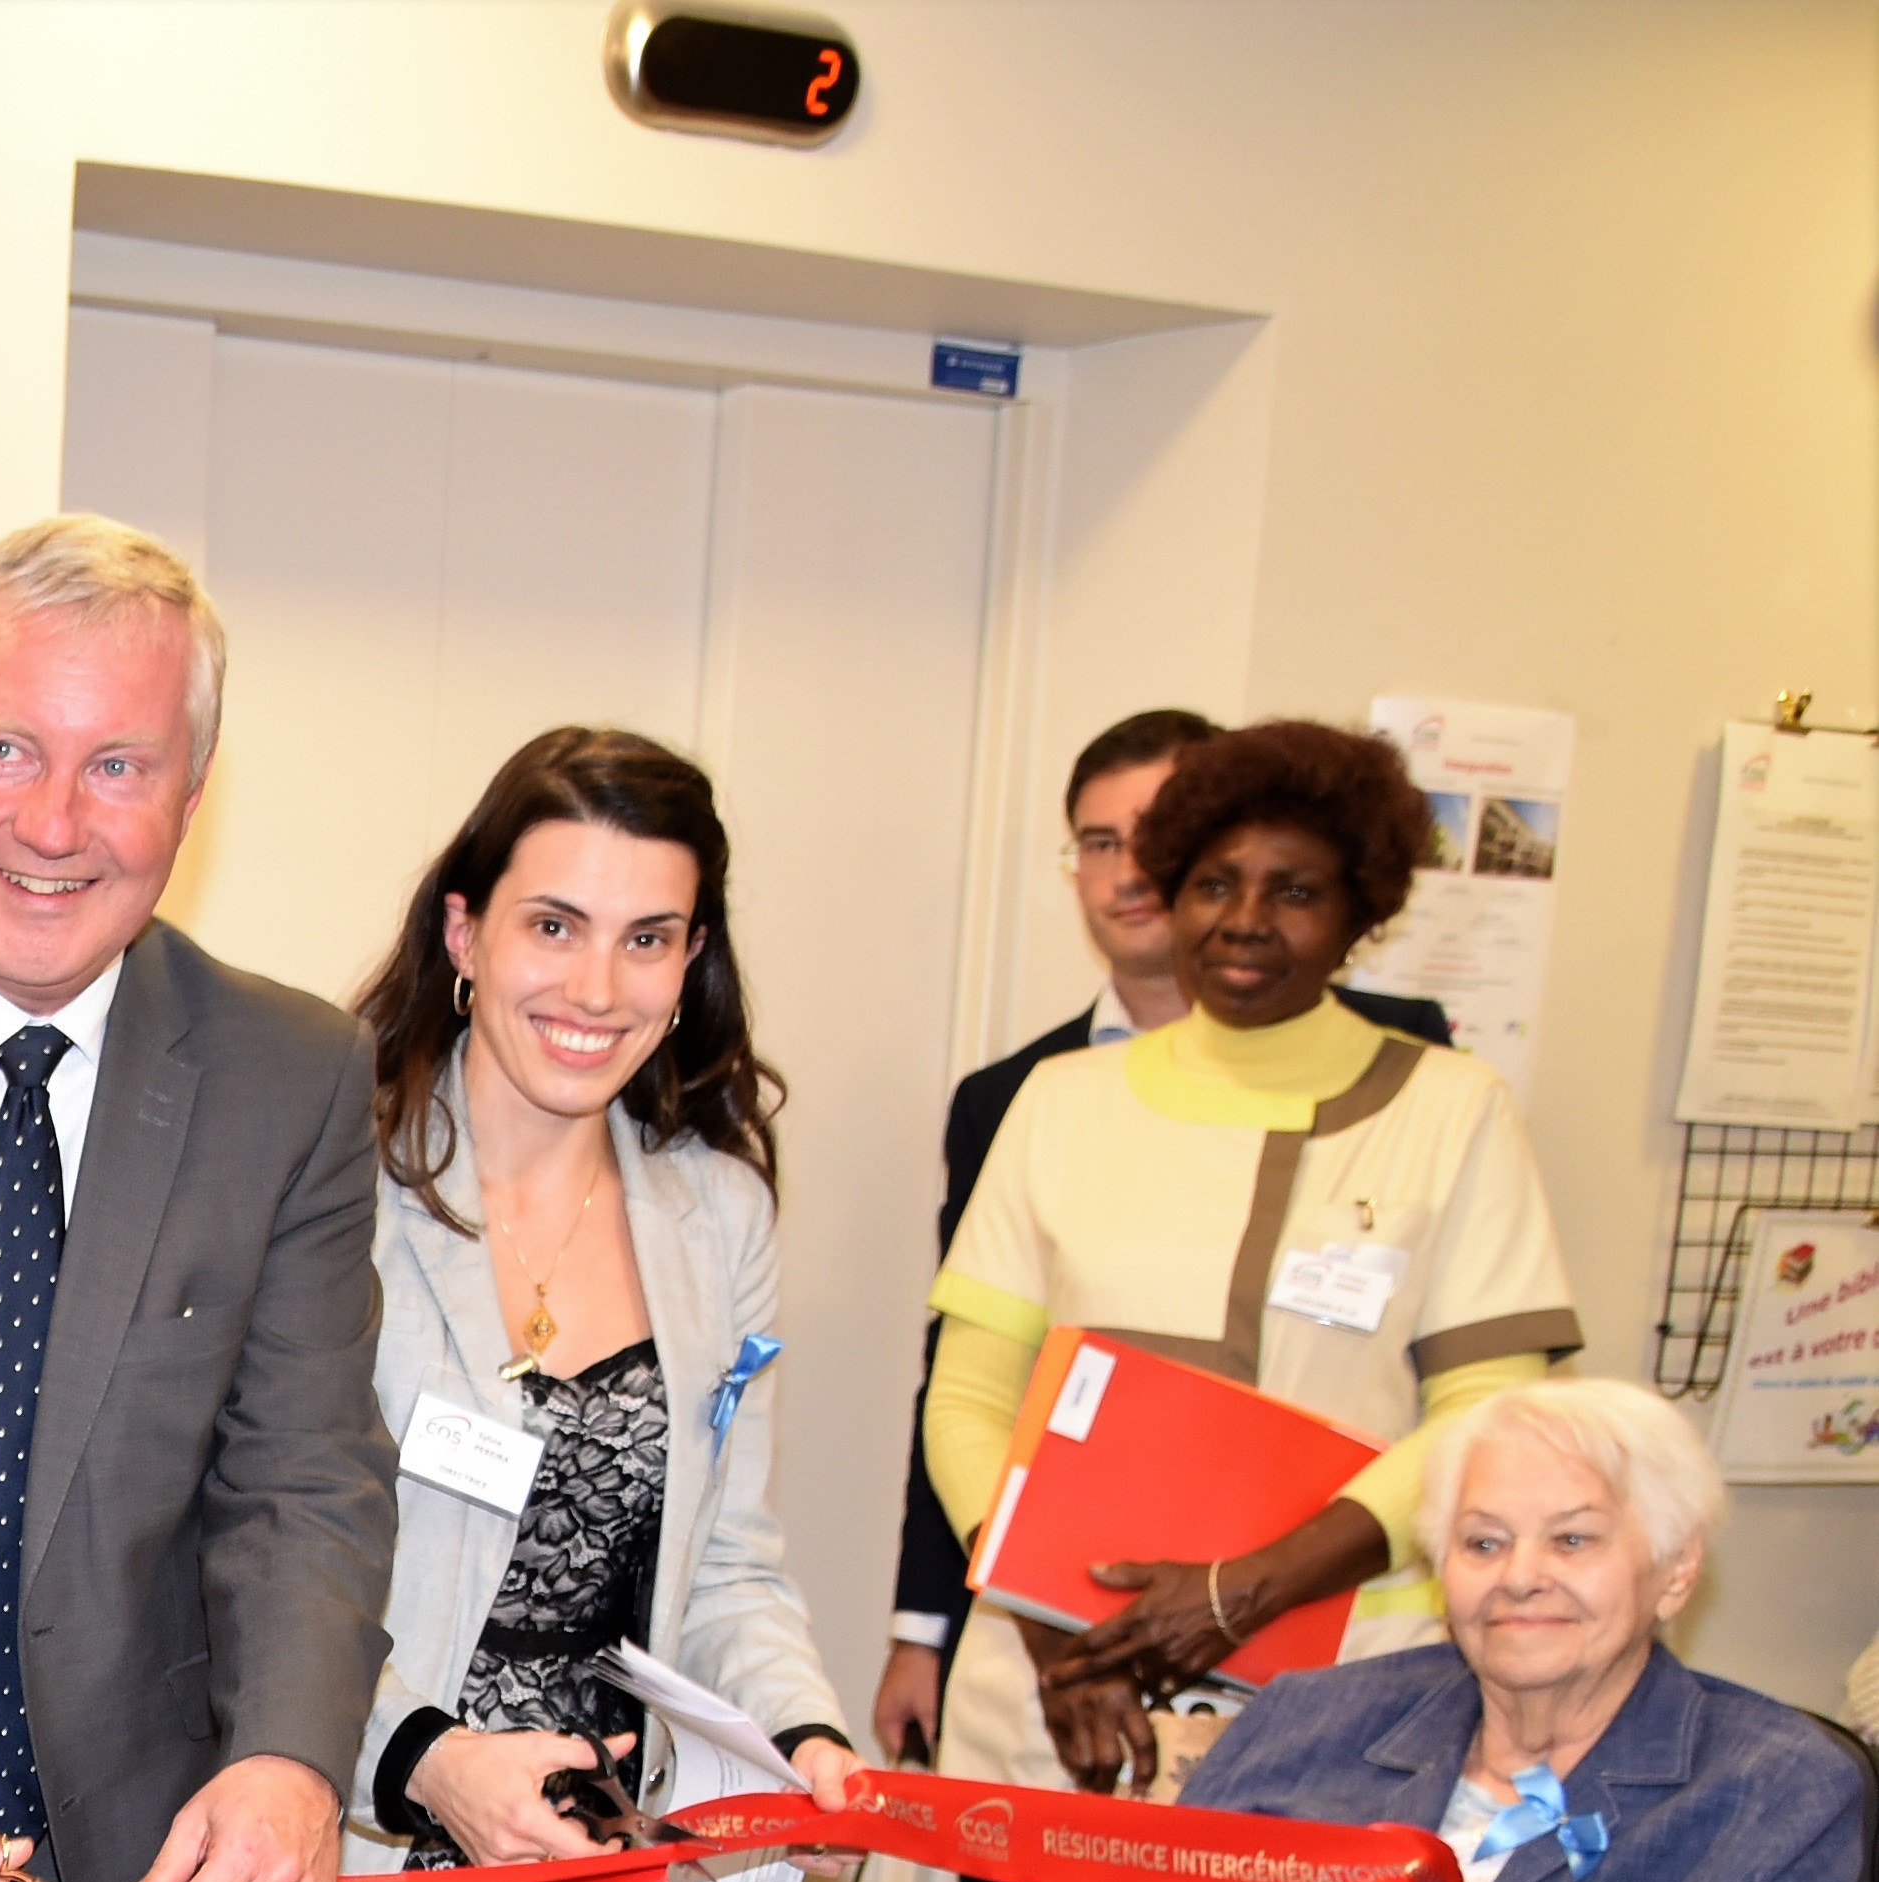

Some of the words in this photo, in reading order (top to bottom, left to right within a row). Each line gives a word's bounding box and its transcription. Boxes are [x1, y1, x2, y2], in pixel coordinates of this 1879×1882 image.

[806, 48, 841, 116] 2
[959, 1816, 1009, 1848] COS
[1042, 1825, 1169, 1872] RÉSIDENCE
